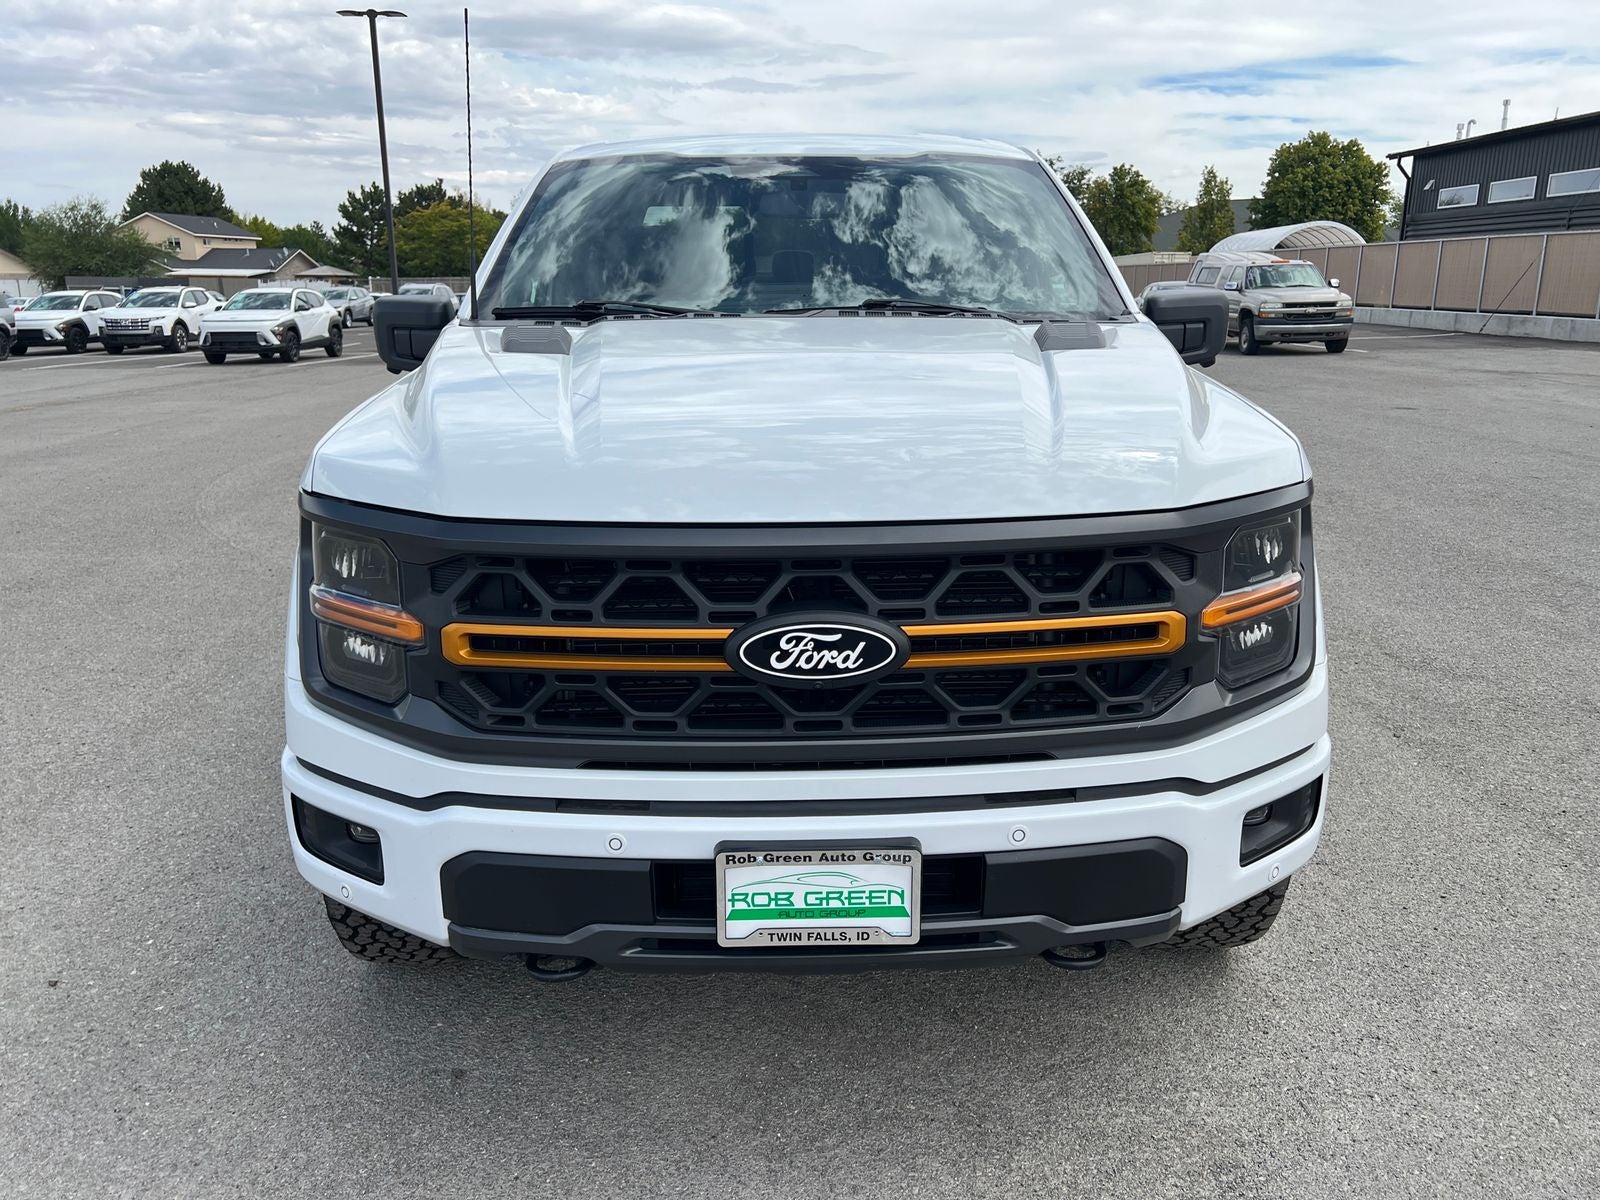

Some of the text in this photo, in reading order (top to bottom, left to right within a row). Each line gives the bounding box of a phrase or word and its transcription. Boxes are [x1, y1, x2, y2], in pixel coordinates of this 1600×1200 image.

[770, 632, 866, 669] Ford
[725, 853, 757, 865] Rob
[763, 853, 812, 863] Green
[819, 852, 856, 862] Auto
[728, 889, 904, 908] ROB GREEN
[777, 909, 866, 919] AUTO GROUP
[767, 931, 870, 943] TWIN FALLS, ID
